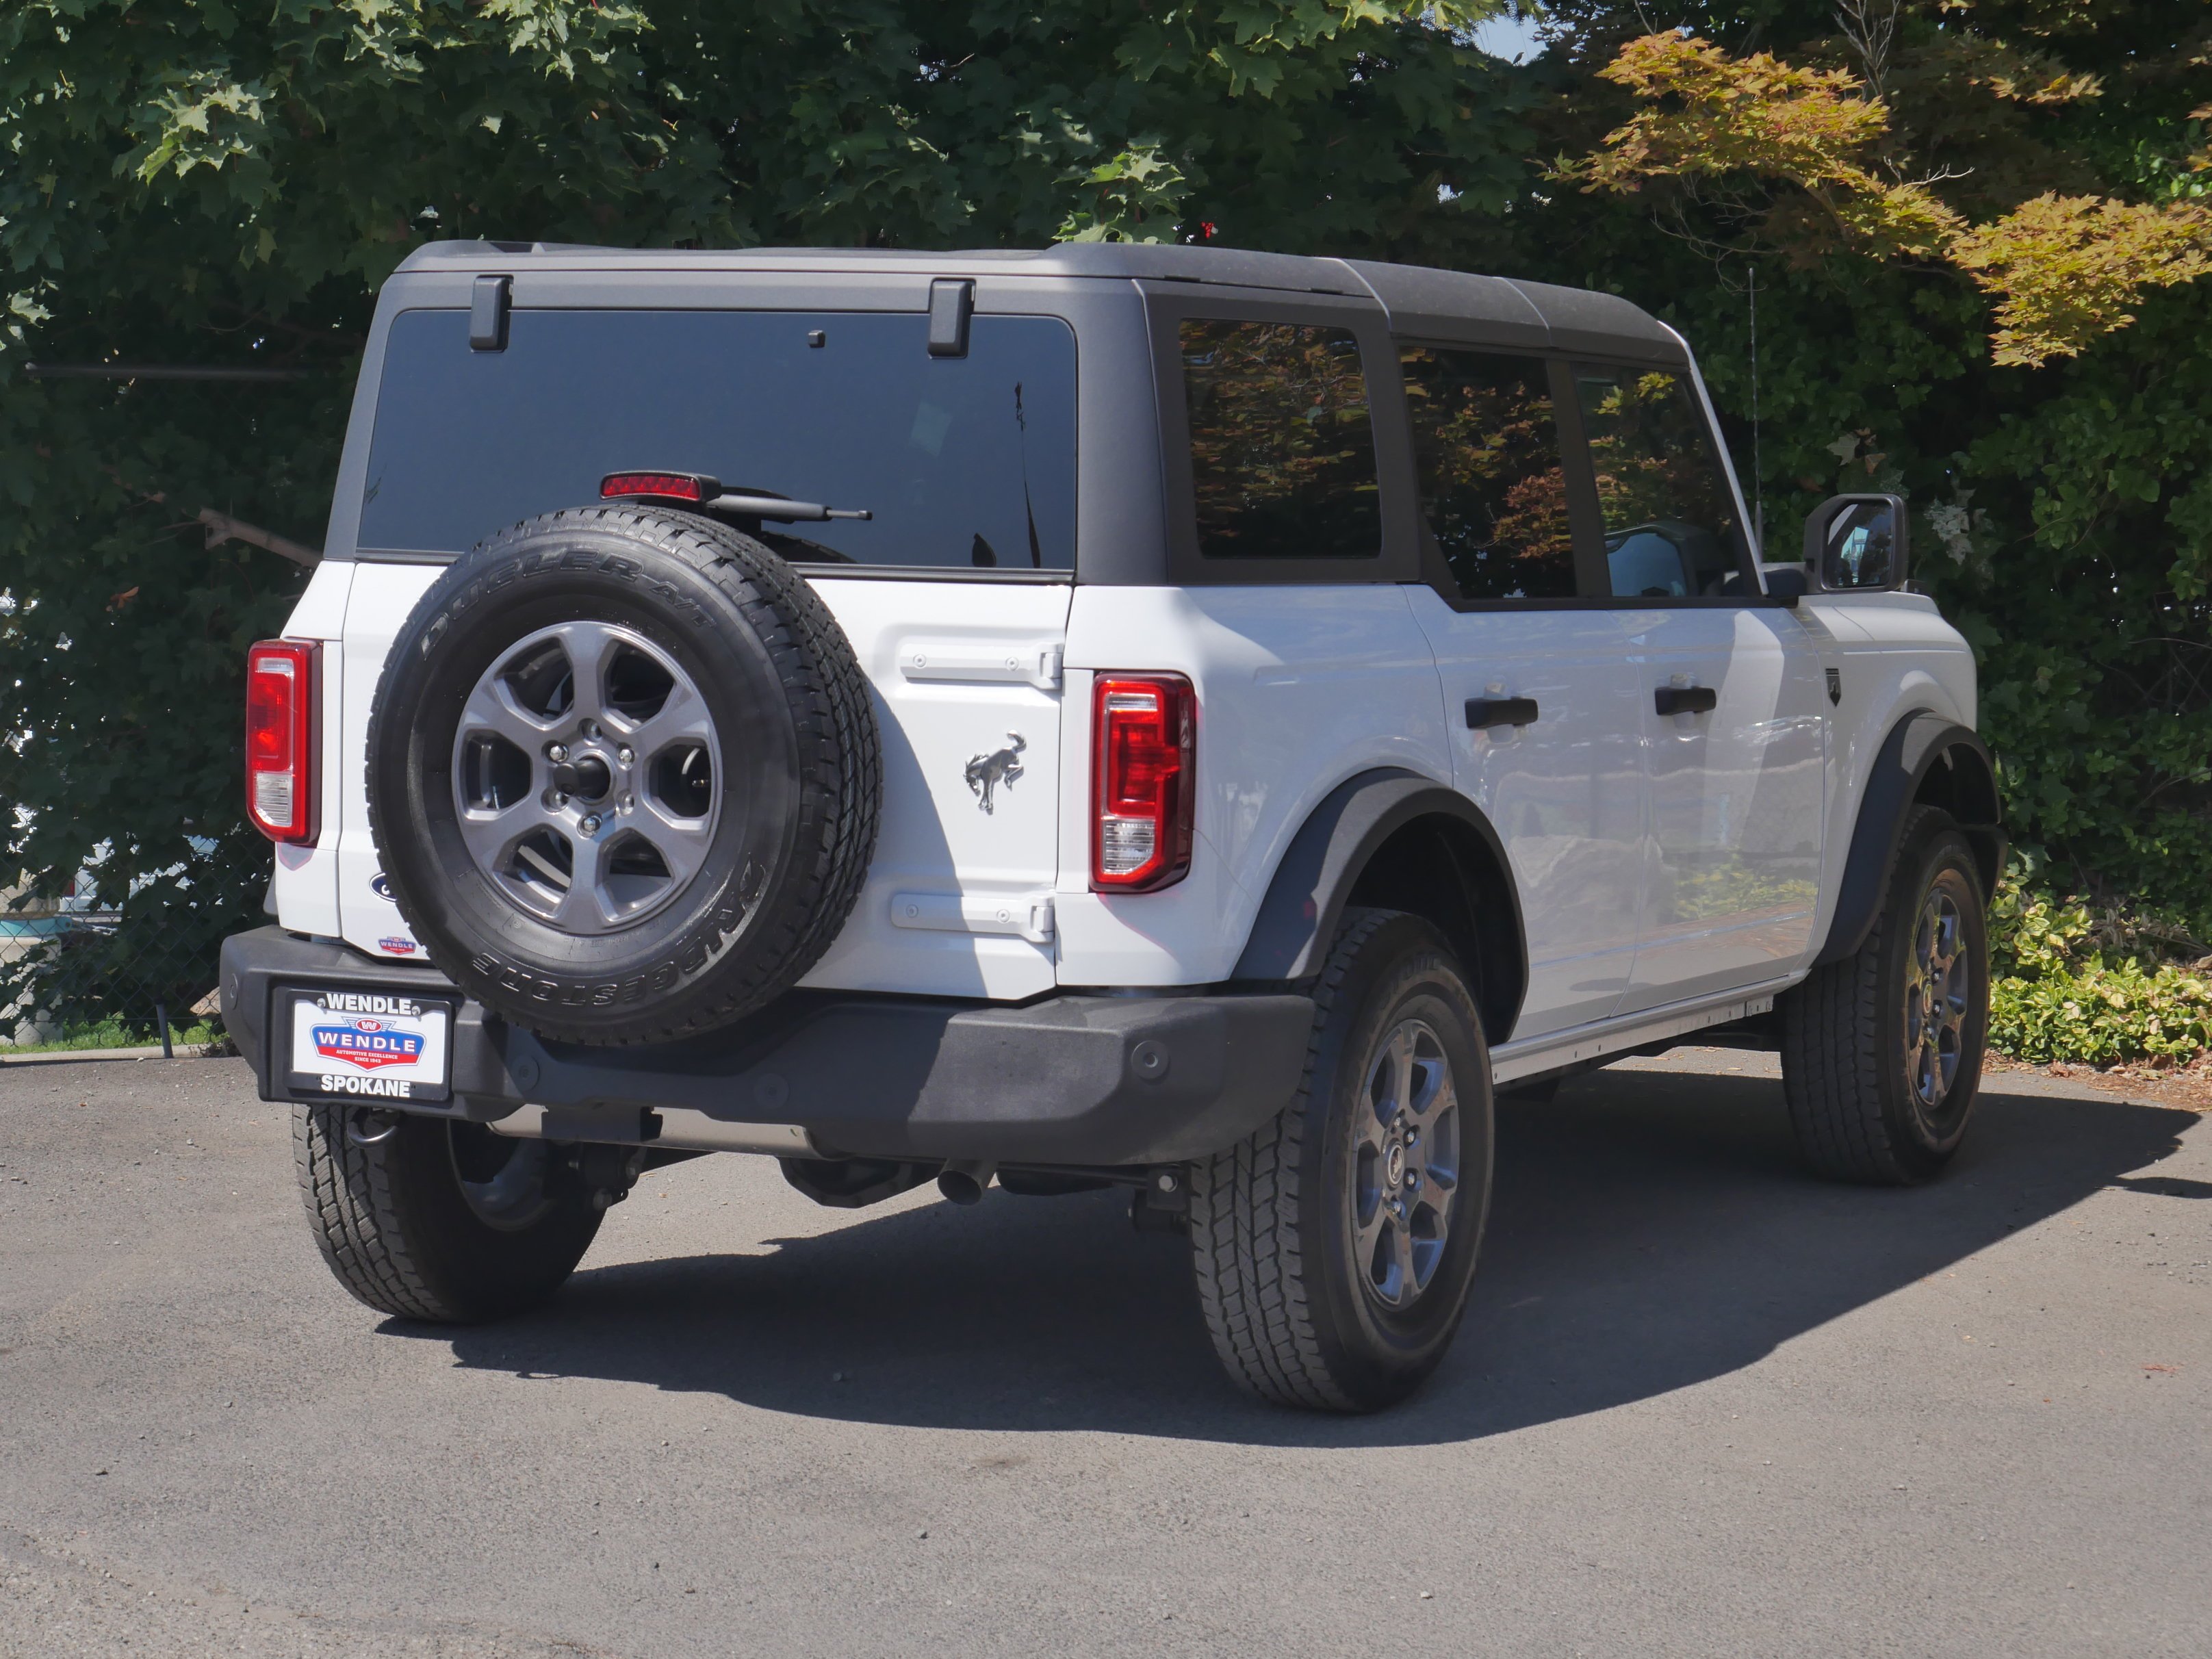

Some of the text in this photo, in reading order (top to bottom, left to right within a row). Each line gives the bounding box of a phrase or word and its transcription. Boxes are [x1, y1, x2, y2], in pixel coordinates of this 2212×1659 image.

[420, 548, 717, 662] DUELER A/T
[326, 993, 412, 1015] WENDLE
[361, 1020, 377, 1031] W
[318, 1031, 415, 1053] WENDLE
[320, 1075, 411, 1098] SPOKANE
